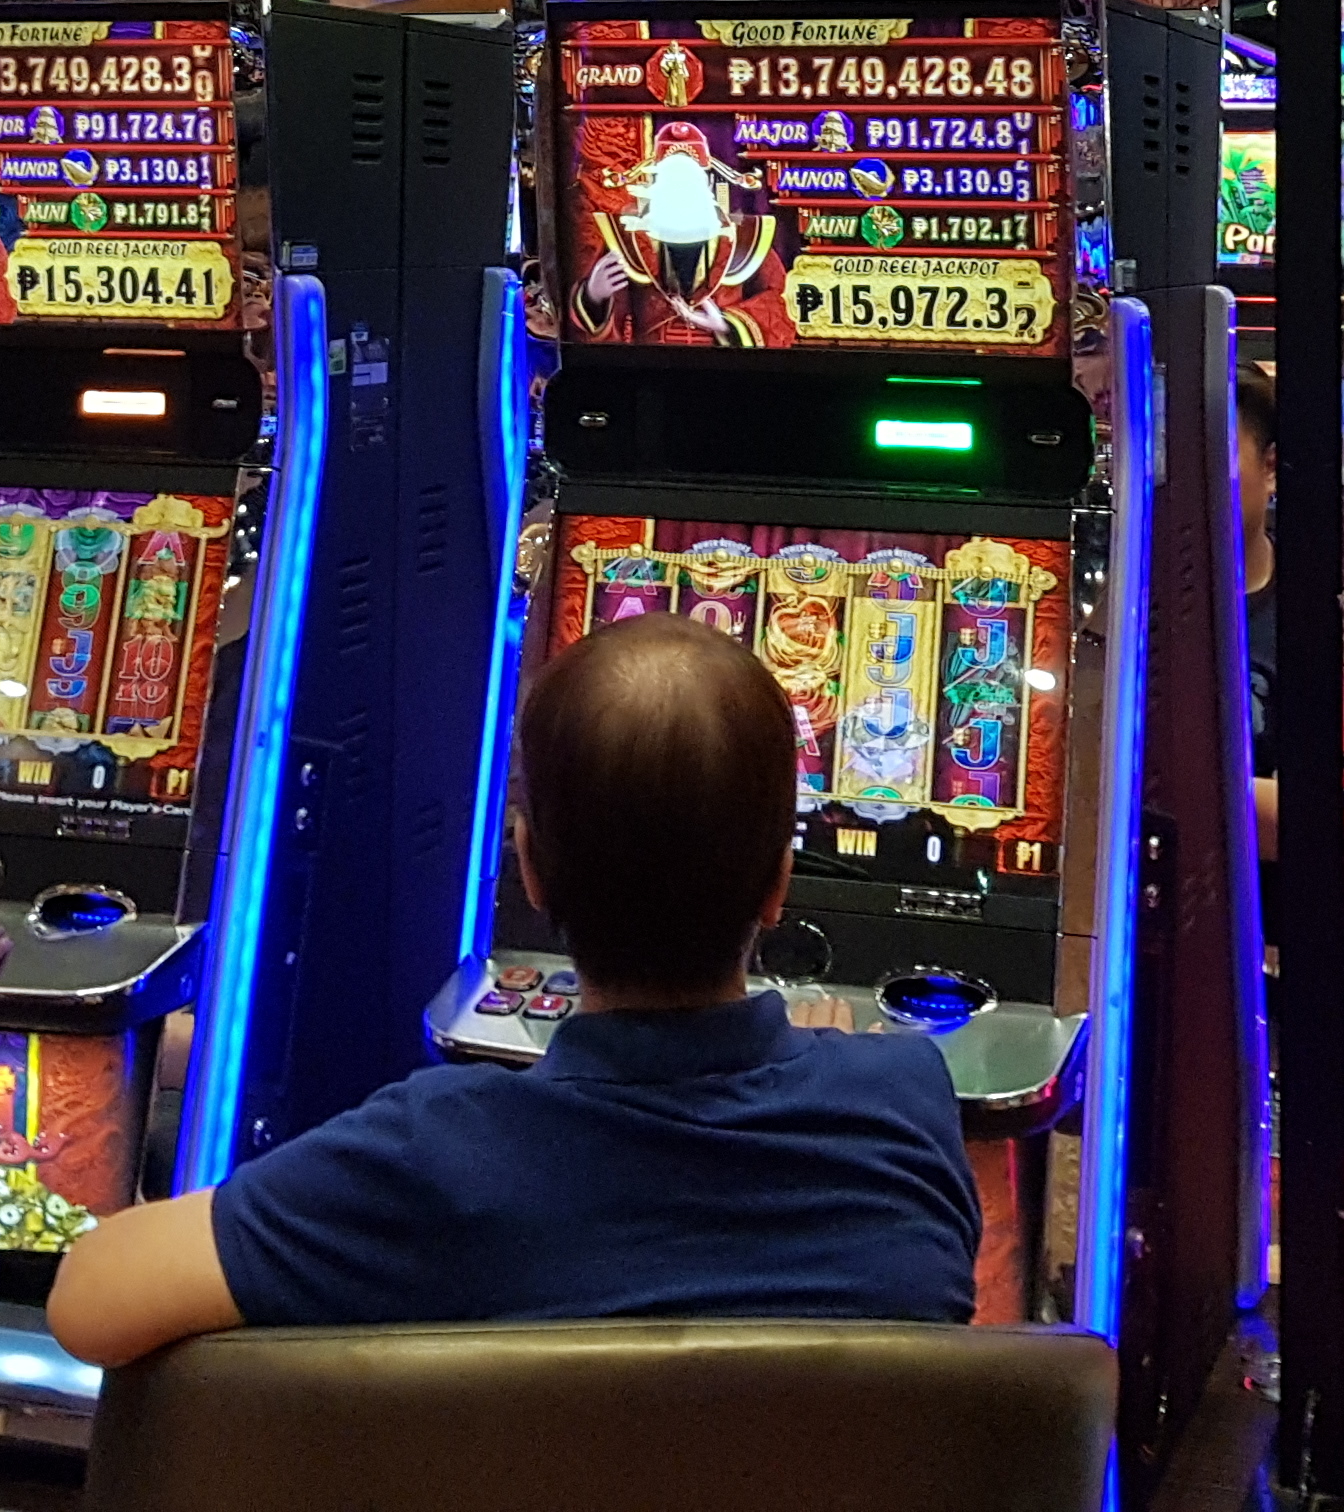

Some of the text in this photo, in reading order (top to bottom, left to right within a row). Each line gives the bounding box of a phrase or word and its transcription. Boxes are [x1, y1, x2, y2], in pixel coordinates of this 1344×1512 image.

[10, 24, 83, 43] FORTUNE
[732, 21, 878, 42] GOOD FORTUNE
[576, 57, 1035, 98] GRAND ₱13,749,428.48
[735, 121, 807, 142] MAJOR
[3, 161, 57, 178] MINOR
[781, 170, 845, 188] MINOR
[25, 205, 67, 222] MINI
[805, 217, 855, 237] MINI
[48, 241, 188, 258] GOLD REEL JACKPOT
[833, 258, 1000, 277] GOLD REEL JACKPOT
[17, 266, 215, 305] ₱15,304.41
[949, 718, 1002, 770] J
[18, 761, 53, 785] WIN
[92, 766, 105, 789] 0
[77, 799, 107, 809] your
[836, 828, 877, 857] WIN
[926, 836, 942, 862] 0
[1016, 840, 1042, 871] ₱1
